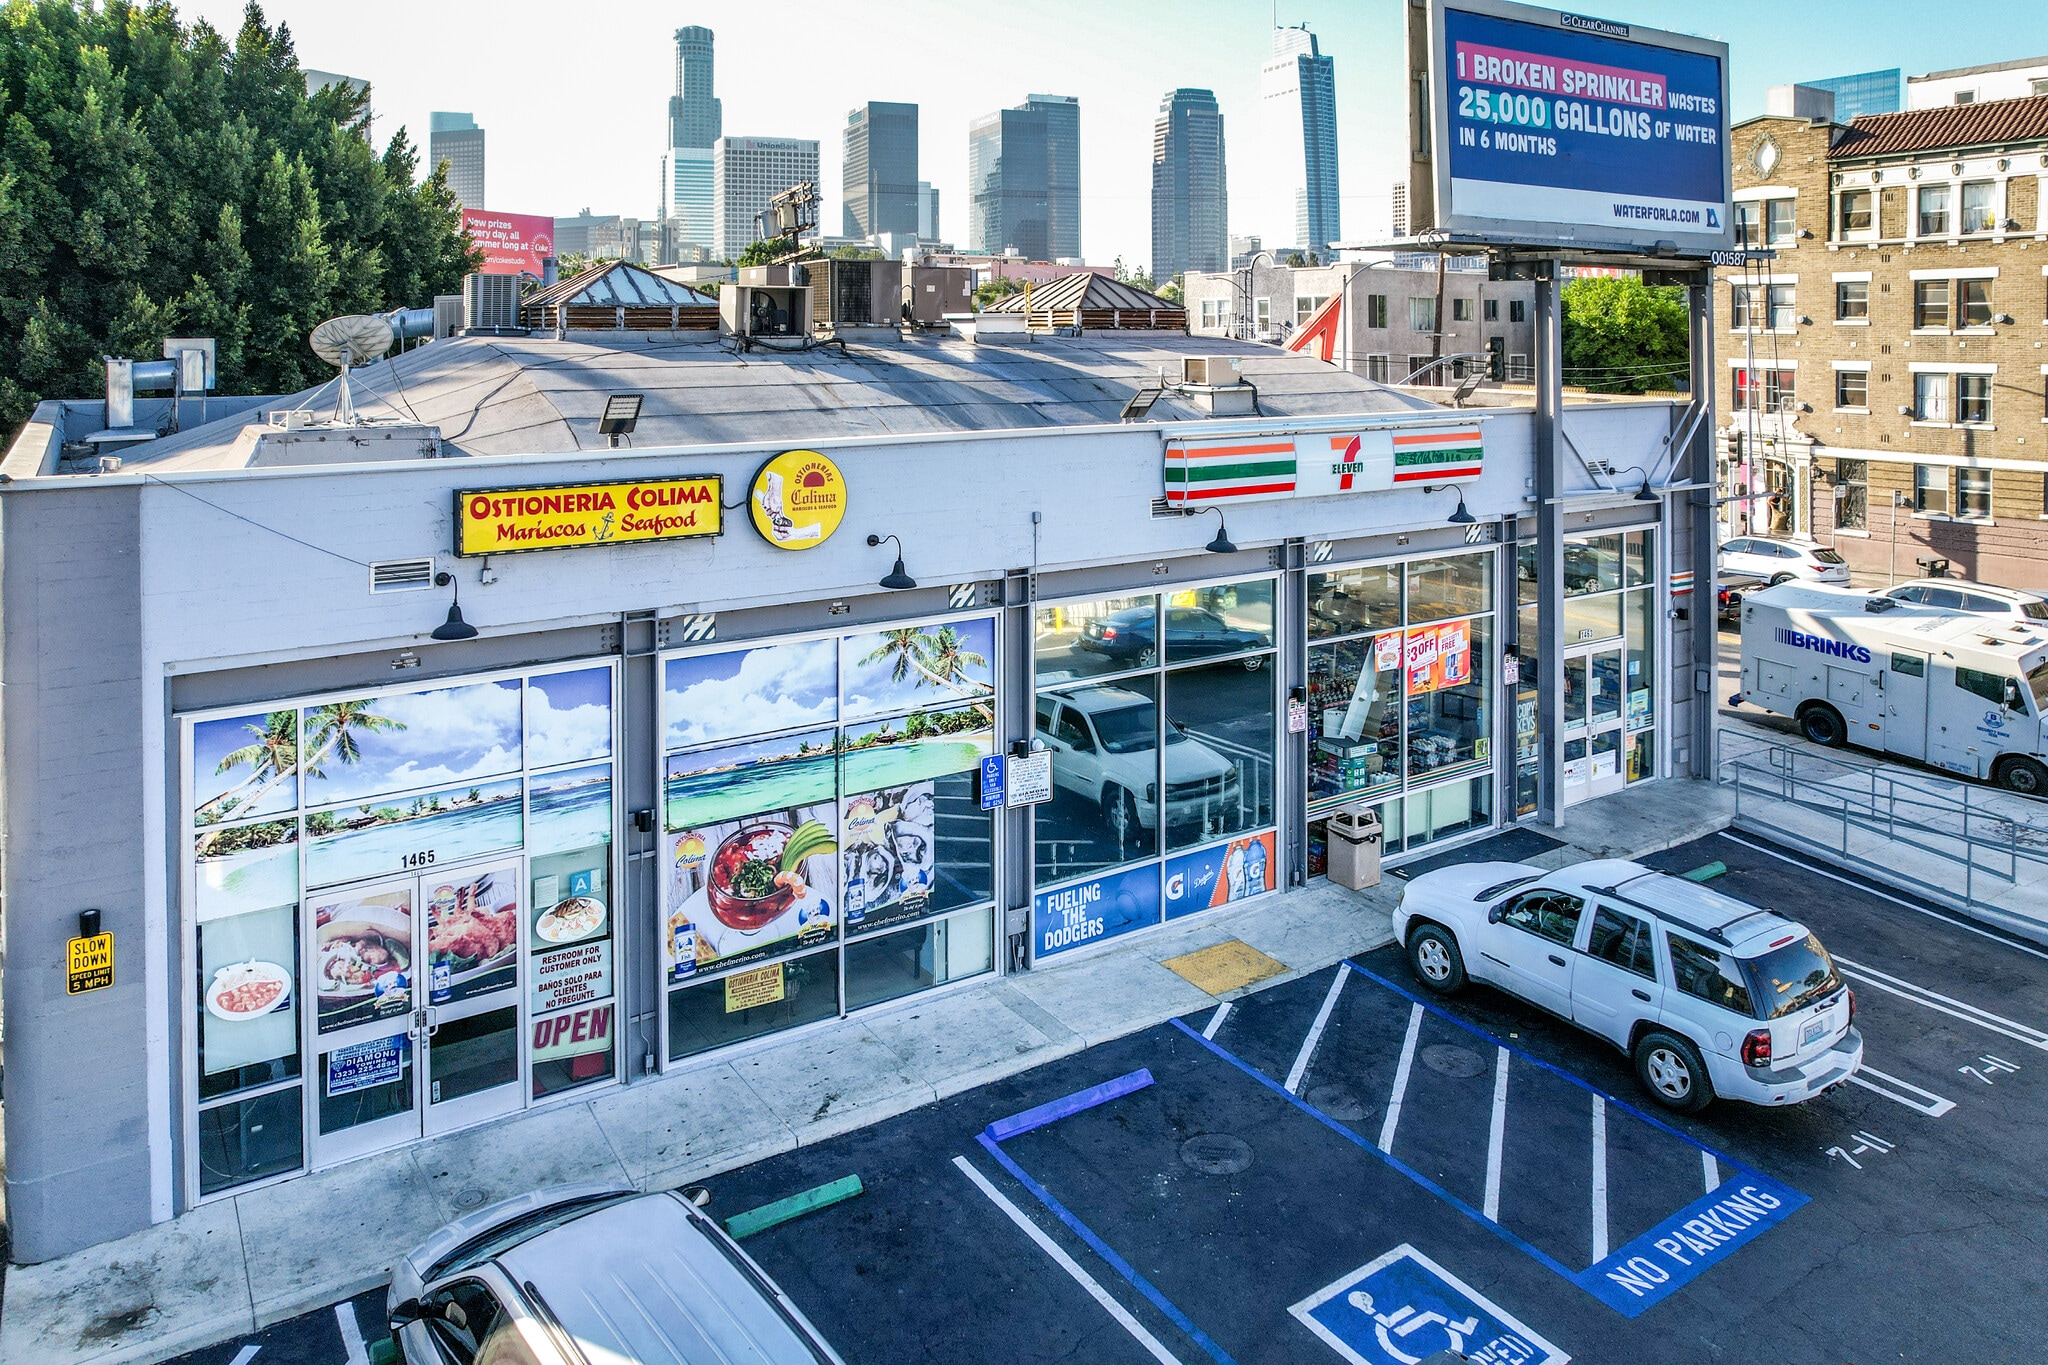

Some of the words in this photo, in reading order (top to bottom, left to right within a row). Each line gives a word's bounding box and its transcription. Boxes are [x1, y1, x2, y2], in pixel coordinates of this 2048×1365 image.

[1456, 52, 1466, 77] 1
[1473, 54, 1556, 91] BROKEN
[1562, 68, 1663, 107] SPRINKLER
[1668, 91, 1716, 115] WASTES
[1459, 86, 1547, 125] 25,000
[1554, 100, 1651, 140] GALLONS
[1655, 121, 1670, 138] OF
[1674, 123, 1717, 145] WATER
[757, 141, 799, 150] UnionBank
[1459, 127, 1475, 147] IN
[1480, 130, 1490, 148] 6
[1495, 132, 1557, 156] MONTHS
[1613, 203, 1700, 223] WATERFORLA.COM
[488, 220, 512, 230] prizes
[492, 229, 509, 241] day,
[510, 231, 520, 240] all
[471, 240, 501, 249] ummer
[502, 240, 520, 252] long
[521, 242, 529, 251] at
[534, 243, 549, 252] Coke
[485, 255, 526, 265] om/cokestudio
[1711, 250, 1747, 267] 001587
[1329, 435, 1362, 490] 7
[795, 462, 834, 485] OSTIONERIAS
[470, 491, 616, 520] OSTIONERIA
[626, 486, 713, 511] COLIMA
[791, 488, 837, 506] Colima
[496, 519, 587, 543] Mariscos
[621, 509, 698, 536] Seafood
[1418, 638, 1435, 656] OFF
[1441, 639, 1456, 652] FREE
[1791, 631, 1872, 664] BRINKS
[1517, 701, 1536, 719] COPY
[1517, 716, 1536, 734] KEYS
[401, 849, 436, 869] 1465
[675, 853, 707, 869] Colima
[574, 877, 588, 892] A
[1165, 872, 1184, 901] G
[1193, 869, 1215, 889] Dodgers
[1047, 882, 1101, 914] FUELING
[857, 910, 921, 930] www.chefmerito.com
[1062, 904, 1087, 928] THE
[1044, 917, 1104, 951] DODGERS
[75, 938, 106, 956] SLOW
[542, 948, 584, 966] RESTROOM
[585, 945, 600, 956] FOR
[74, 952, 107, 970] DOWN
[539, 958, 581, 975] CUSTOMER
[582, 954, 602, 966] ONLY
[698, 951, 766, 973] www.chefmerito.com
[71, 971, 92, 982] SPEED
[93, 967, 111, 977] LIMIT
[73, 981, 81, 991] 5
[85, 975, 109, 989] MPH
[538, 979, 563, 993] BAÑOS
[564, 974, 583, 987] SOLO
[584, 970, 603, 982] PARA
[728, 972, 759, 989] OSTIONERIA
[760, 967, 780, 981] COLIMA
[545, 999, 556, 1010] NO
[557, 989, 596, 1006] PREGUNTE
[553, 982, 588, 998] CLIENTES
[533, 1007, 610, 1050] OPEN
[346, 1049, 397, 1067] DIAMOND
[355, 1057, 388, 1069] TOWING
[1958, 1054, 2021, 1085] 7-11
[1825, 1130, 1896, 1170] 7-11
[1605, 1256, 1670, 1297] NO
[1653, 1185, 1782, 1266] PARKING
